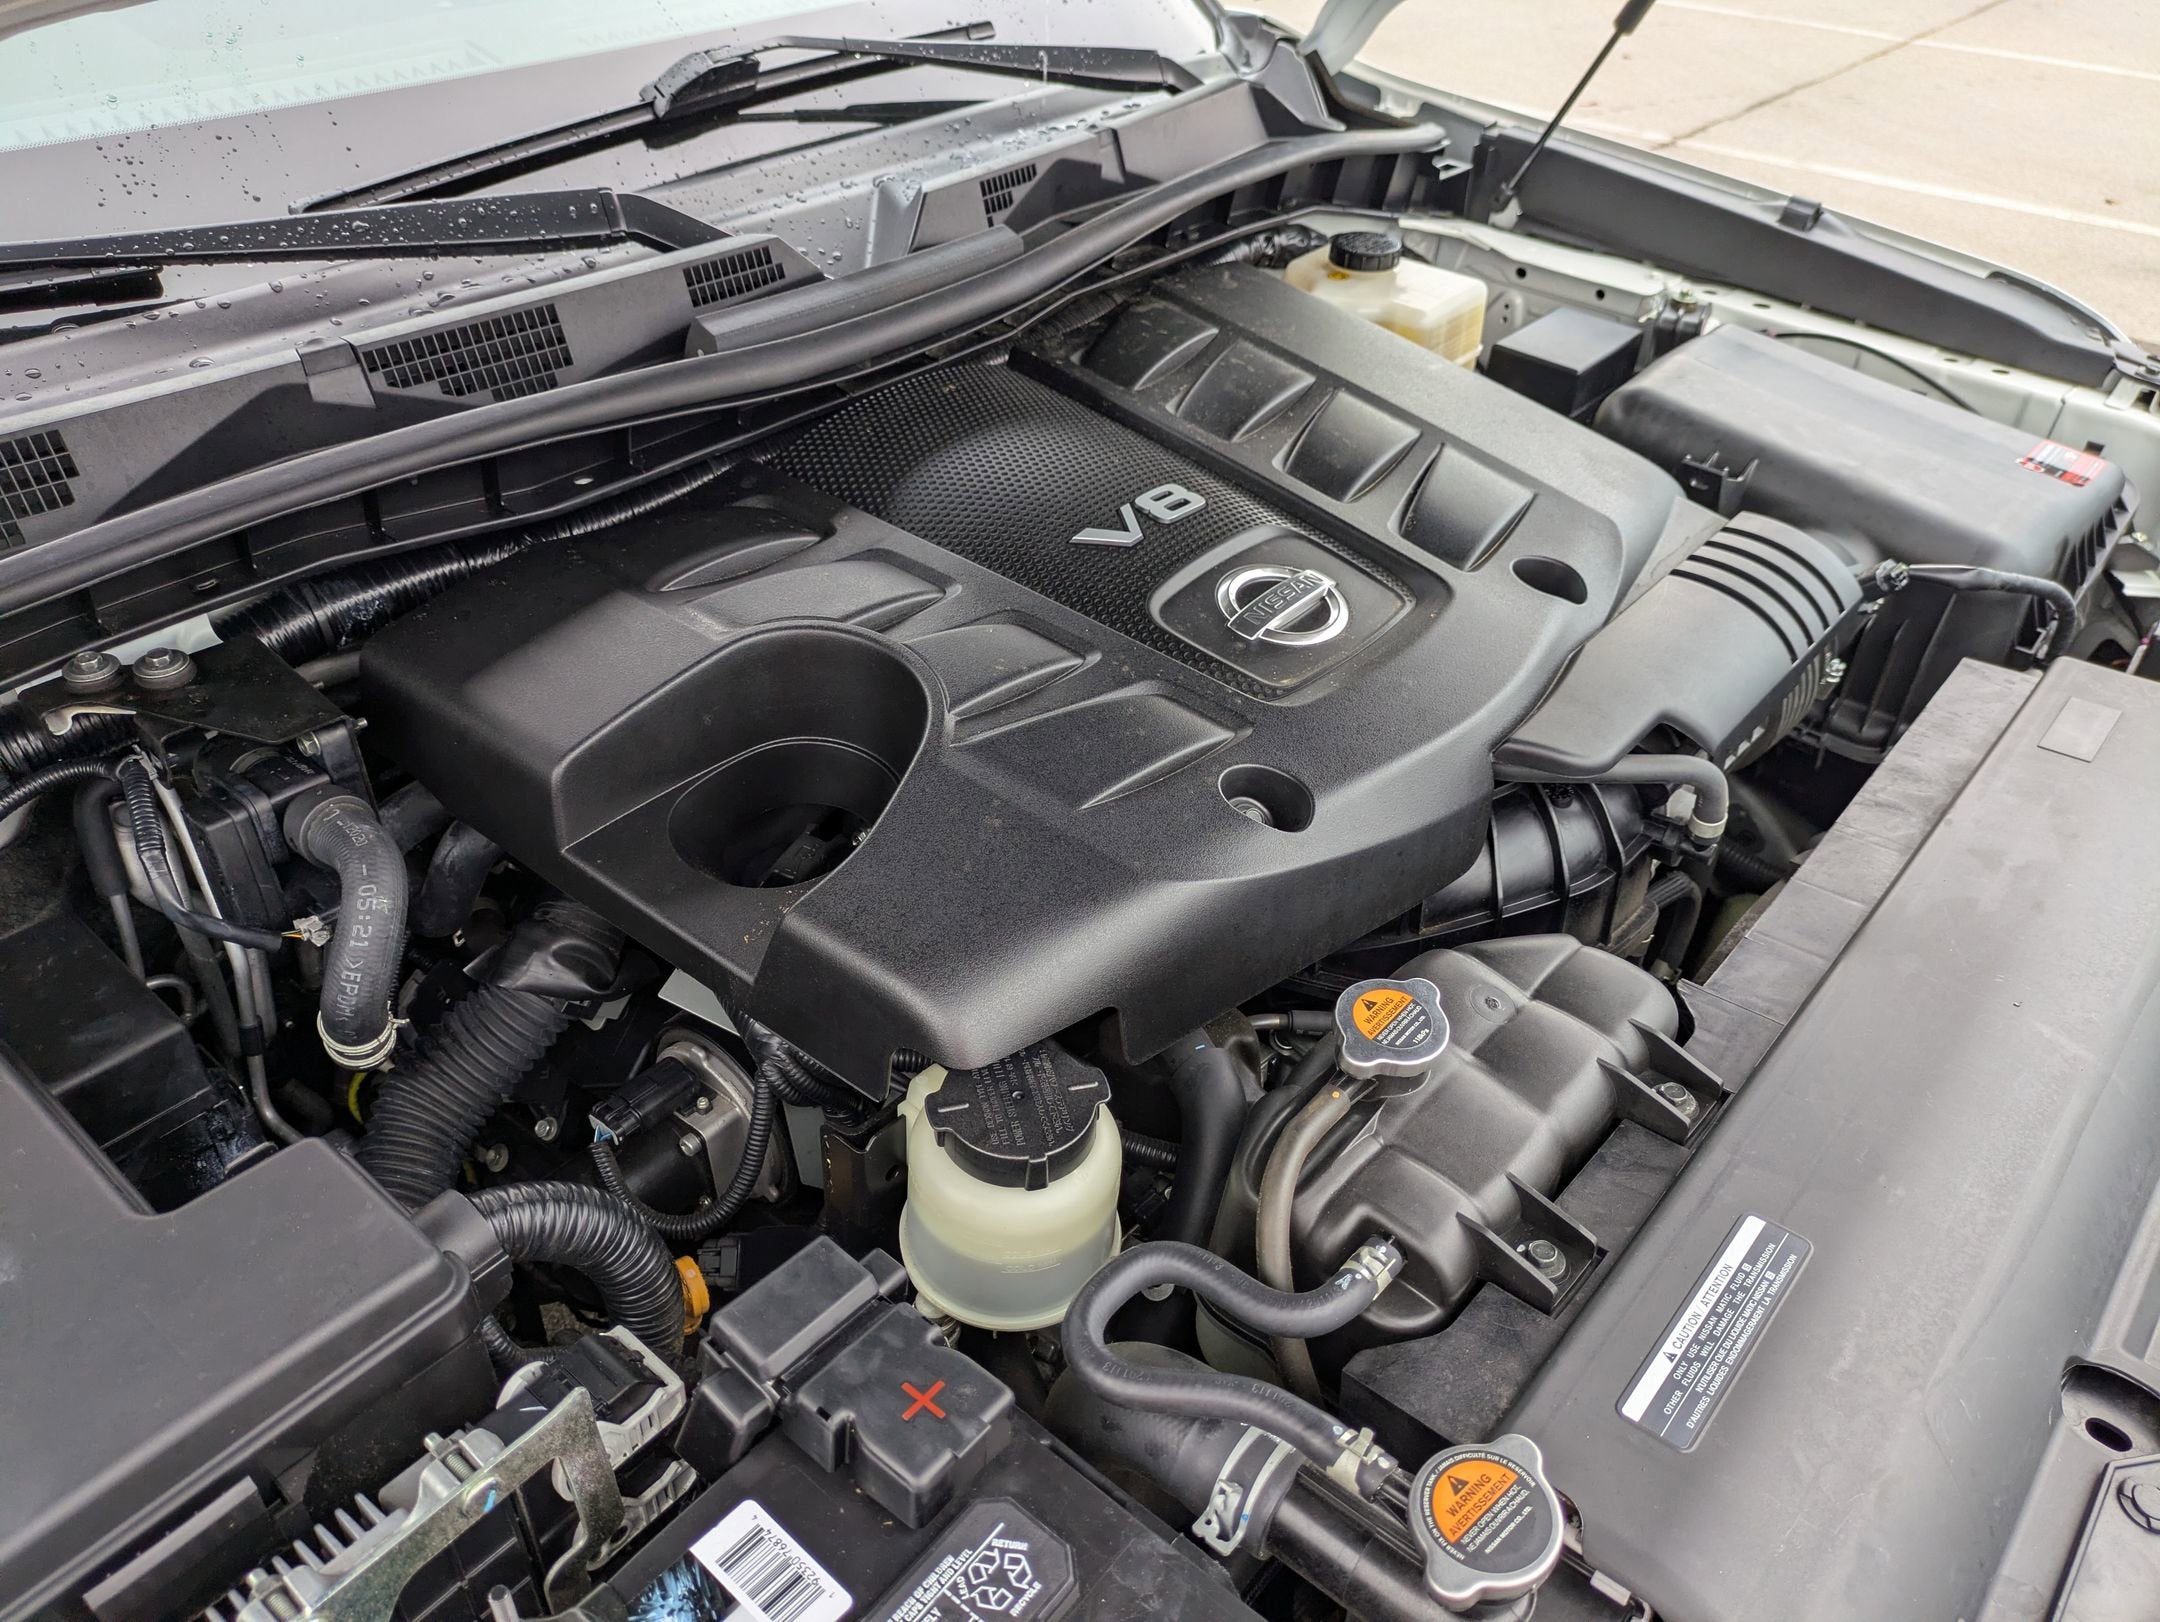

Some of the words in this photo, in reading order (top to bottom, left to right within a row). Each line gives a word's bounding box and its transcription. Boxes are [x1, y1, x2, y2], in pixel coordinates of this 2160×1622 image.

[1069, 483, 1206, 547] V8
[1241, 572, 1324, 625] NISSAN
[349, 884, 377, 947] 05:21
[1363, 996, 1393, 1025] WARNING
[1367, 996, 1407, 1035] AVERTISSEMENT
[981, 1068, 990, 1083] LEVE
[981, 1102, 994, 1127] DEXRON
[998, 1080, 1016, 1117] STEERING
[995, 1114, 1003, 1122] TO
[999, 1127, 1009, 1144] FILL
[1011, 1120, 1025, 1145] POWER
[990, 1131, 999, 1144] USE
[1671, 1311, 1702, 1350] CAUTION
[1699, 1263, 1733, 1306] ATTENTION
[1714, 1347, 1727, 1362] QUE
[1722, 1338, 1733, 1348] DU
[1728, 1316, 1747, 1340] LIQUIDE
[1741, 1299, 1757, 1317] MATIC
[1752, 1279, 1769, 1300] NISSAN
[1663, 1389, 1683, 1415] OTHER
[1681, 1361, 1701, 1386] FLUIDS
[1699, 1339, 1714, 1357] WILL
[1712, 1308, 1735, 1336] DAMAGE
[1733, 1290, 1745, 1304] THE
[1743, 1242, 1776, 1287] TRANSMISSION
[1673, 1361, 1688, 1380] ONLY
[1687, 1343, 1700, 1358] USE
[1698, 1315, 1718, 1340] NISSAN
[1715, 1292, 1732, 1312] MATIC
[1729, 1272, 1745, 1290] FLUID
[1685, 1395, 1710, 1428] D'AUTRES
[1706, 1365, 1729, 1395] LIQUIDES
[1724, 1305, 1766, 1365] ENDOMMAGERAIENT
[1761, 1296, 1771, 1305] LA
[1767, 1254, 1797, 1295] TRANSMISSION
[1500, 1457, 1507, 1465] LE
[1446, 1472, 1491, 1517] WARNING
[1448, 1472, 1511, 1536] AVERTISSEMENT
[1426, 1517, 1434, 1528] THE
[1432, 1528, 1440, 1537] ON
[1460, 1525, 1479, 1544] NEVER
[1477, 1511, 1493, 1528] OPEN
[1491, 1494, 1509, 1513] WHEN
[1466, 1542, 1476, 1552] NE
[1473, 1526, 1492, 1545] JAMAIS
[1489, 1510, 1507, 1529] OUVRIR
[1499, 1521, 1515, 1538] MOTOR
[764, 1529, 792, 1557] 76874
[991, 1538, 1028, 1550] RETURN
[1446, 1545, 1465, 1560] NEVER
[791, 1556, 820, 1585] 92350
[893, 1597, 914, 1620] REACH
[914, 1586, 924, 1598] OF
[922, 1554, 953, 1588] CHILDREN
[905, 1602, 922, 1621] CAPS
[921, 1582, 940, 1603] TIGHT
[939, 1567, 953, 1583] AND
[952, 1547, 972, 1569] LEVEL
[956, 1576, 969, 1600] LEAD
[1009, 1581, 1042, 1617] RECYCLE
